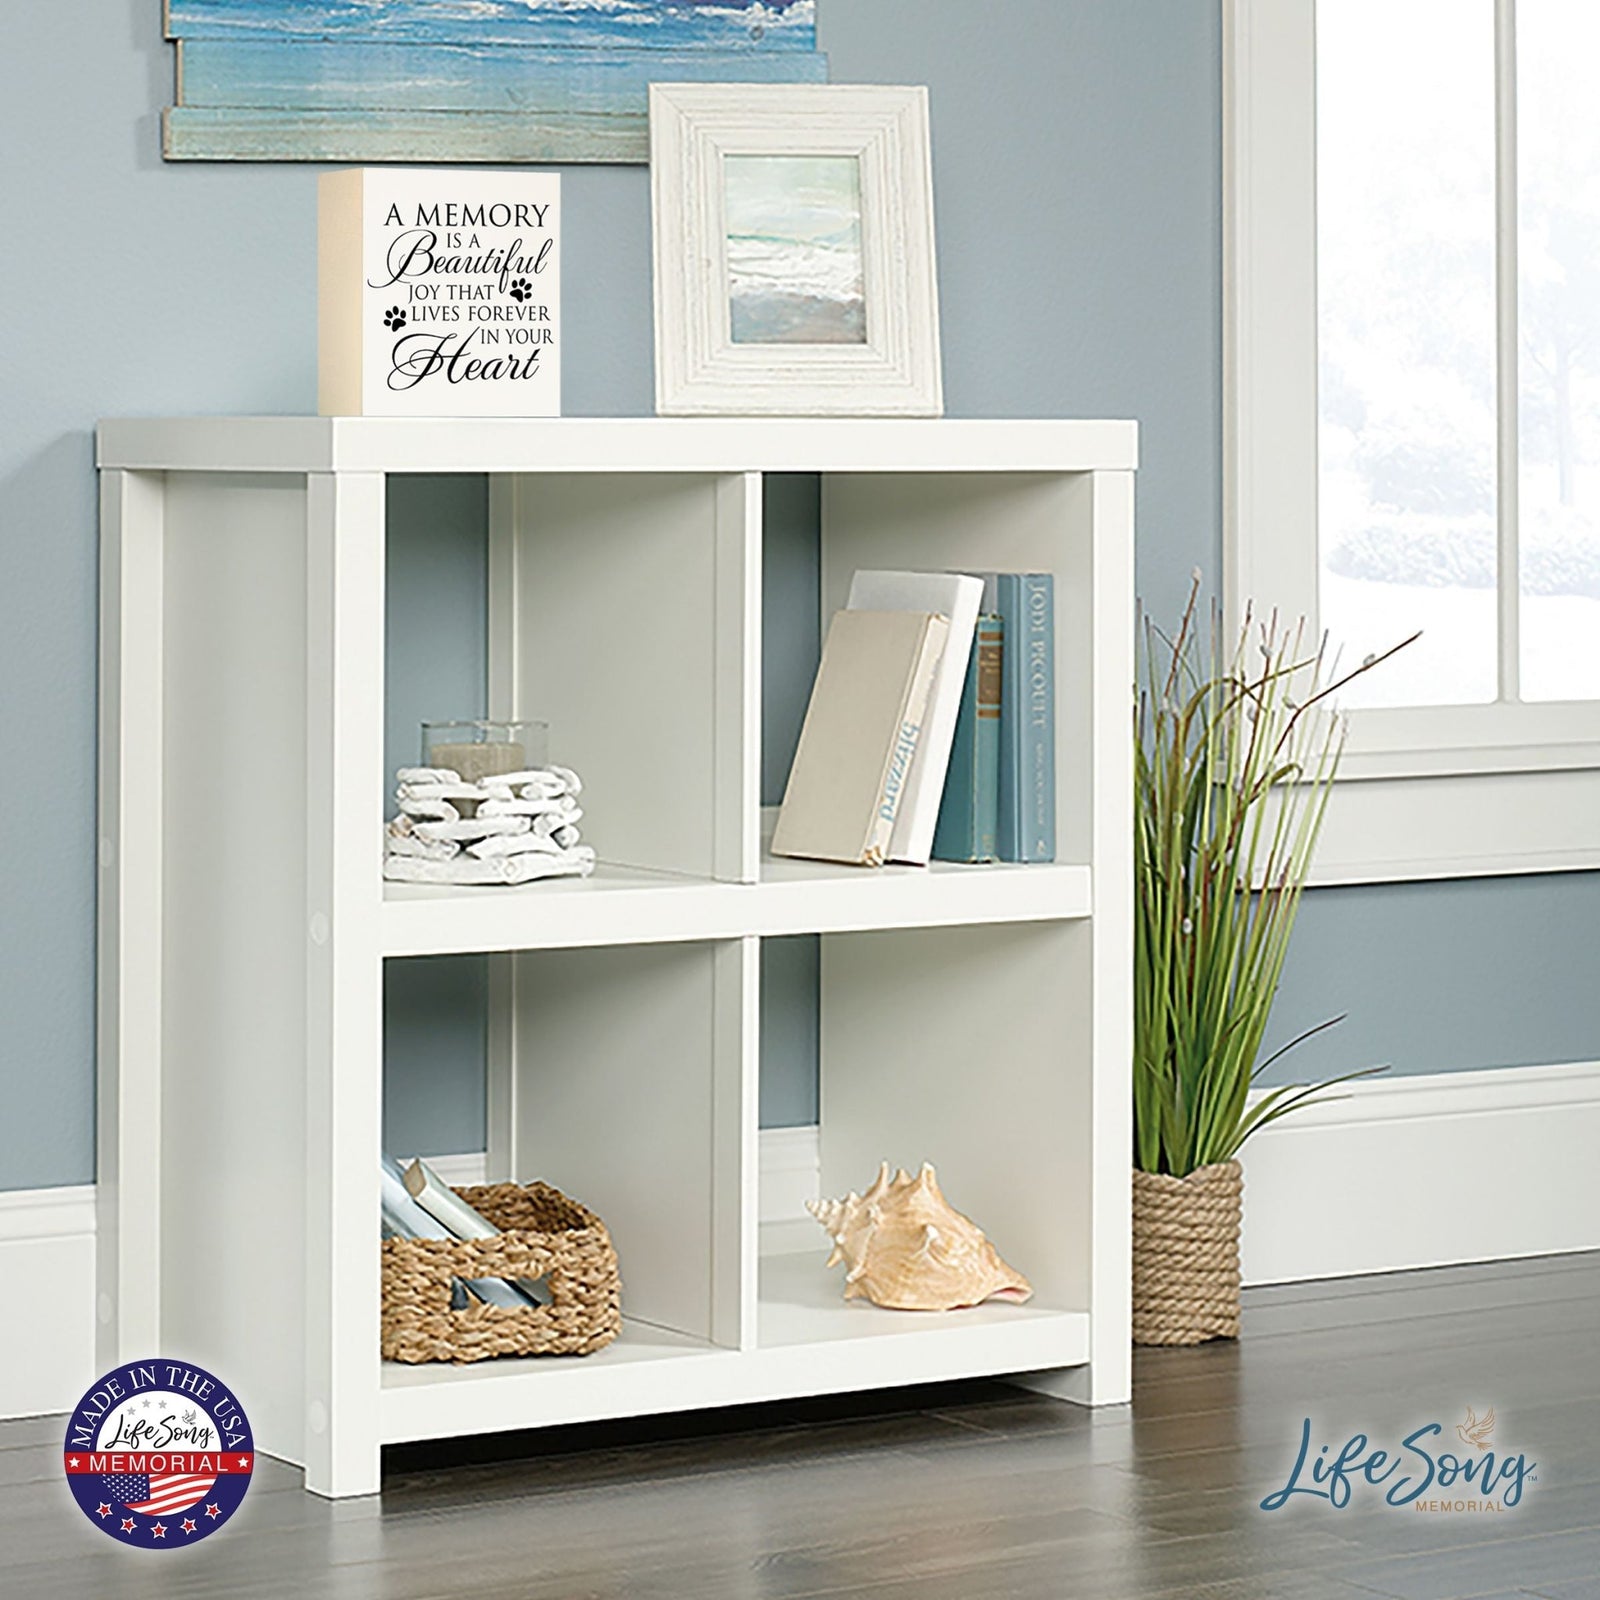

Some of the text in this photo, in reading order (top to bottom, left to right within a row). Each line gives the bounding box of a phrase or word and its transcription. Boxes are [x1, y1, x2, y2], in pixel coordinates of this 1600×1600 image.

[384, 203, 550, 227] A MEMORY
[446, 233, 481, 249] IS A
[367, 229, 554, 294] Beautiful
[408, 284, 495, 304] JOY THAT
[412, 305, 551, 322] LIVES FOREVER
[481, 328, 554, 344] IN YOUR
[387, 326, 542, 391] Heart
[1028, 584, 1048, 632] JODI
[879, 721, 920, 824] blizzard
